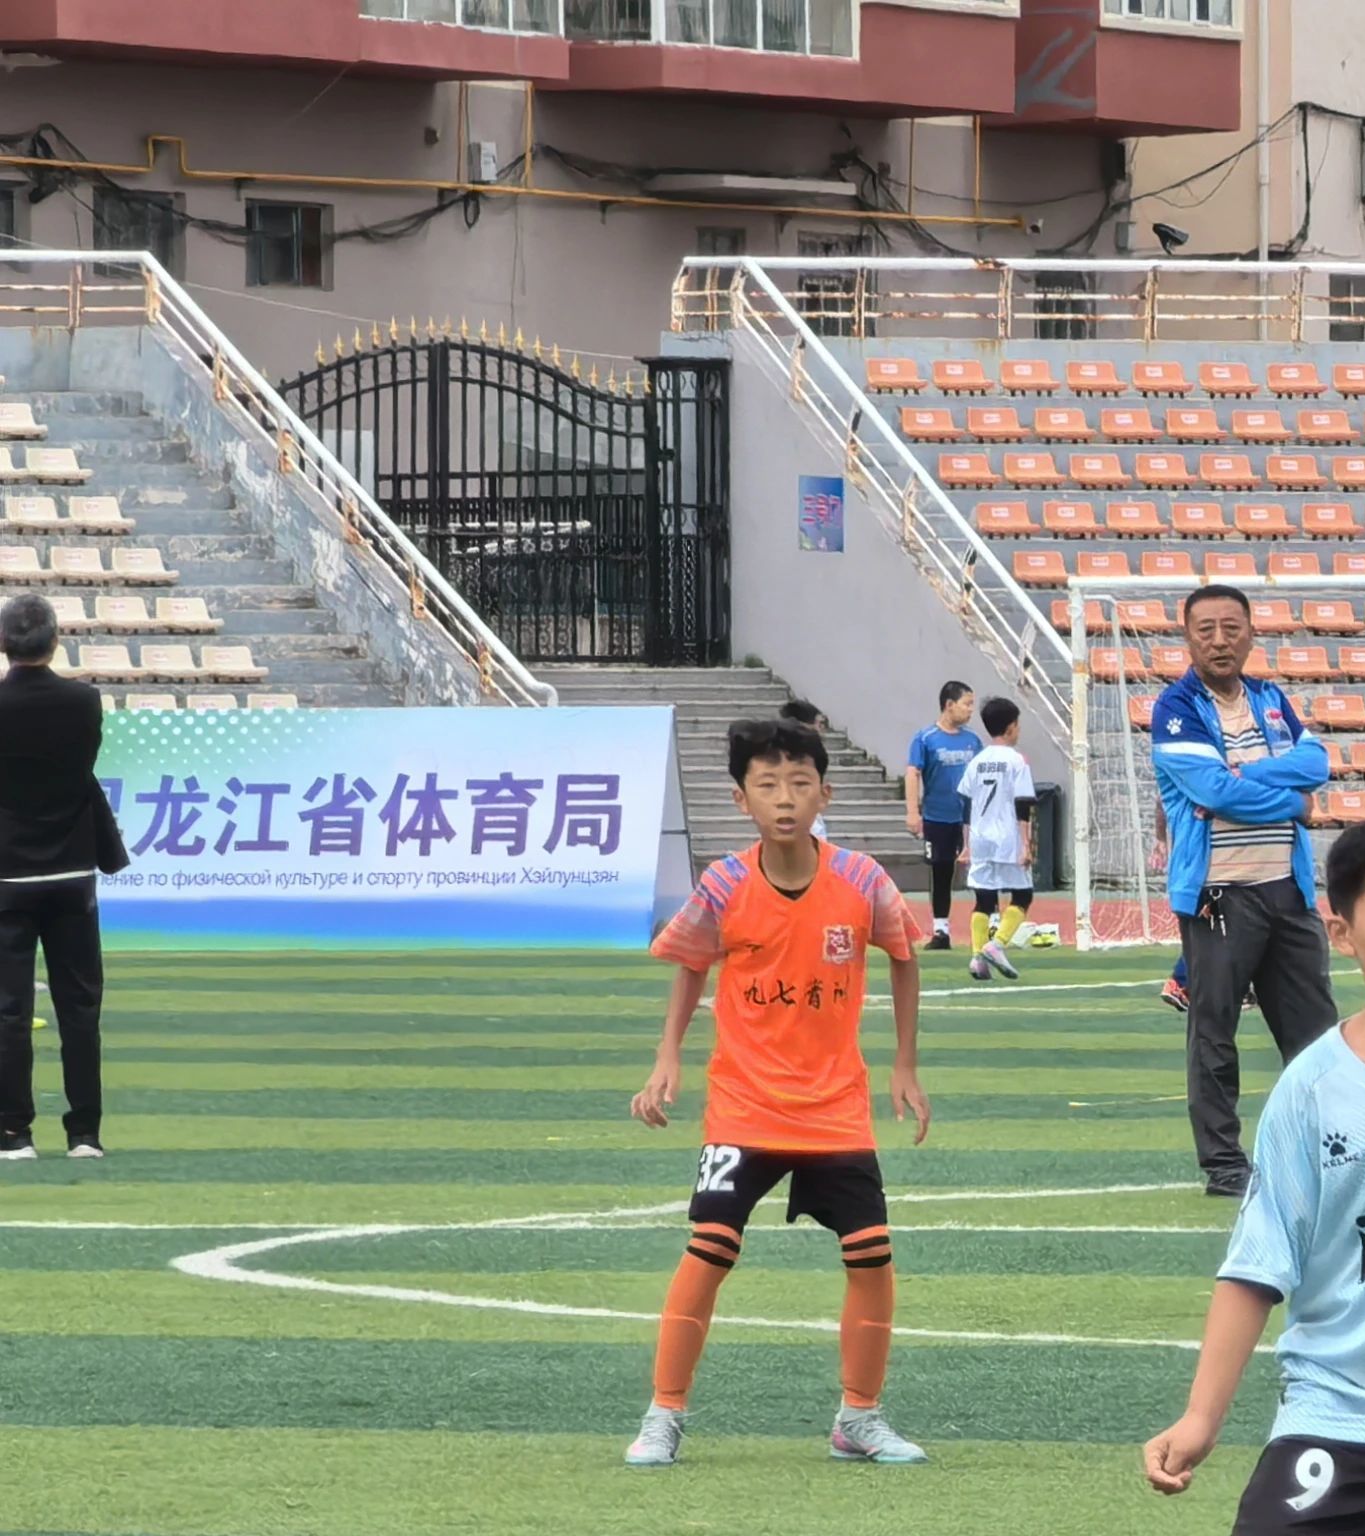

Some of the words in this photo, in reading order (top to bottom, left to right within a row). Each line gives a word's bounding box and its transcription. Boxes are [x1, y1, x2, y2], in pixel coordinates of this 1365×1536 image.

[982, 779, 998, 818] 7
[149, 874, 168, 886] по
[172, 870, 272, 890] физической
[275, 872, 348, 889] культуре
[352, 872, 363, 885] и
[367, 871, 423, 888] спорту
[426, 870, 516, 887] провинции
[1322, 1151, 1361, 1169] KELME
[1285, 1448, 1335, 1511] 9
